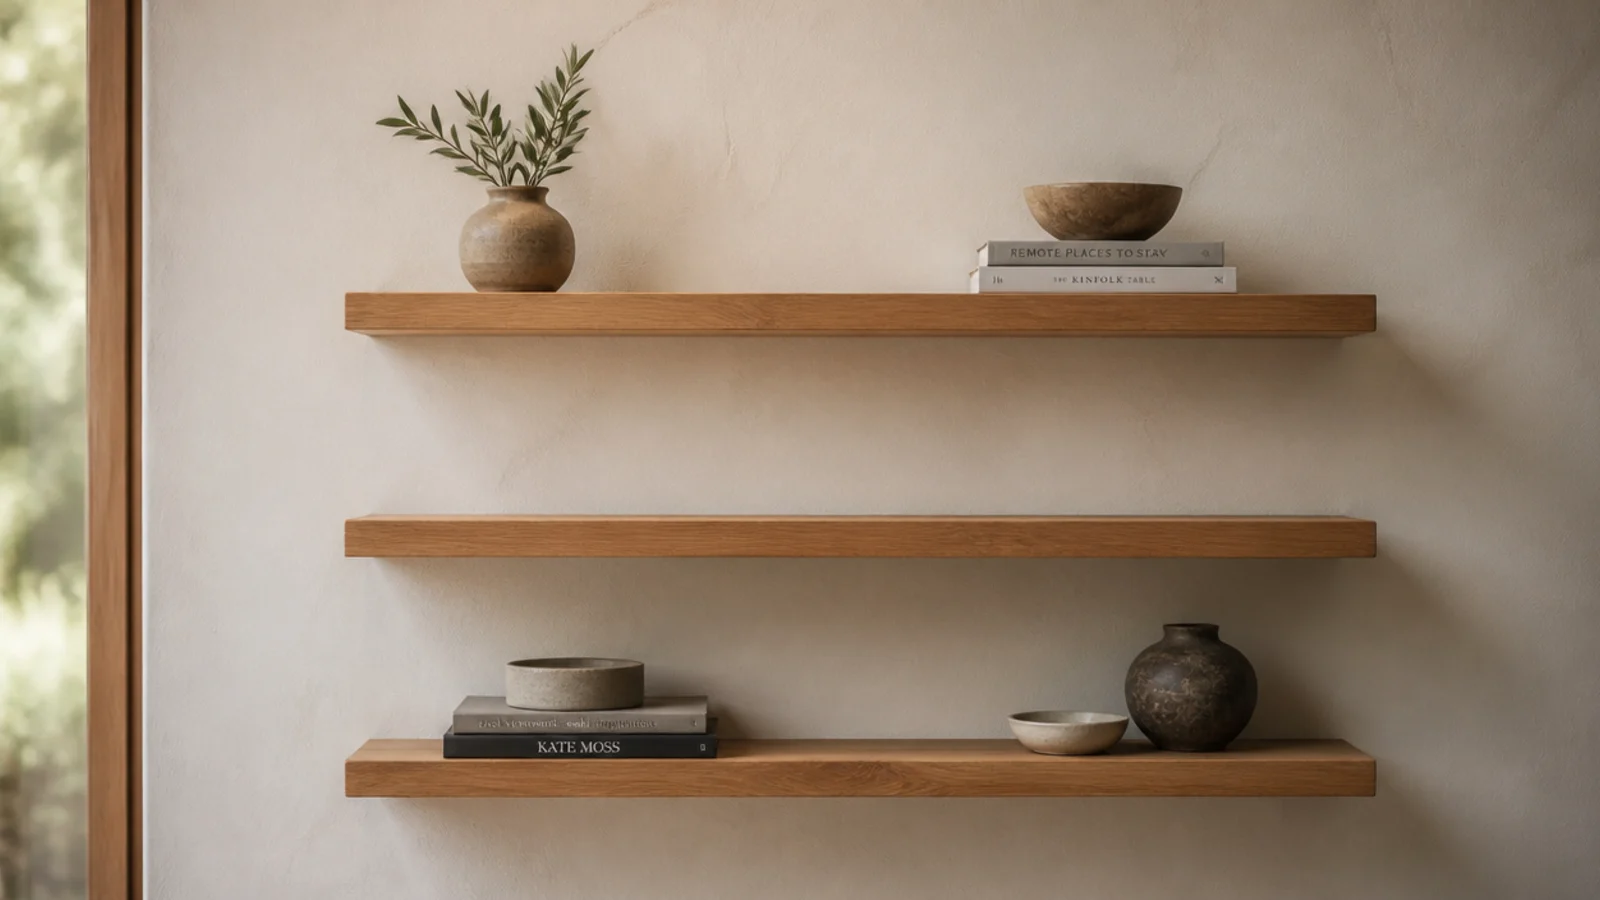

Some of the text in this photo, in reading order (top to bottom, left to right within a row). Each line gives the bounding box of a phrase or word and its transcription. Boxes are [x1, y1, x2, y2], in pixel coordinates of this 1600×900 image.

[1010, 248, 1168, 258] REMOTE PLACES TO STAY
[1071, 275, 1123, 284] KINFOLK
[537, 740, 620, 753] KATE MOSS
